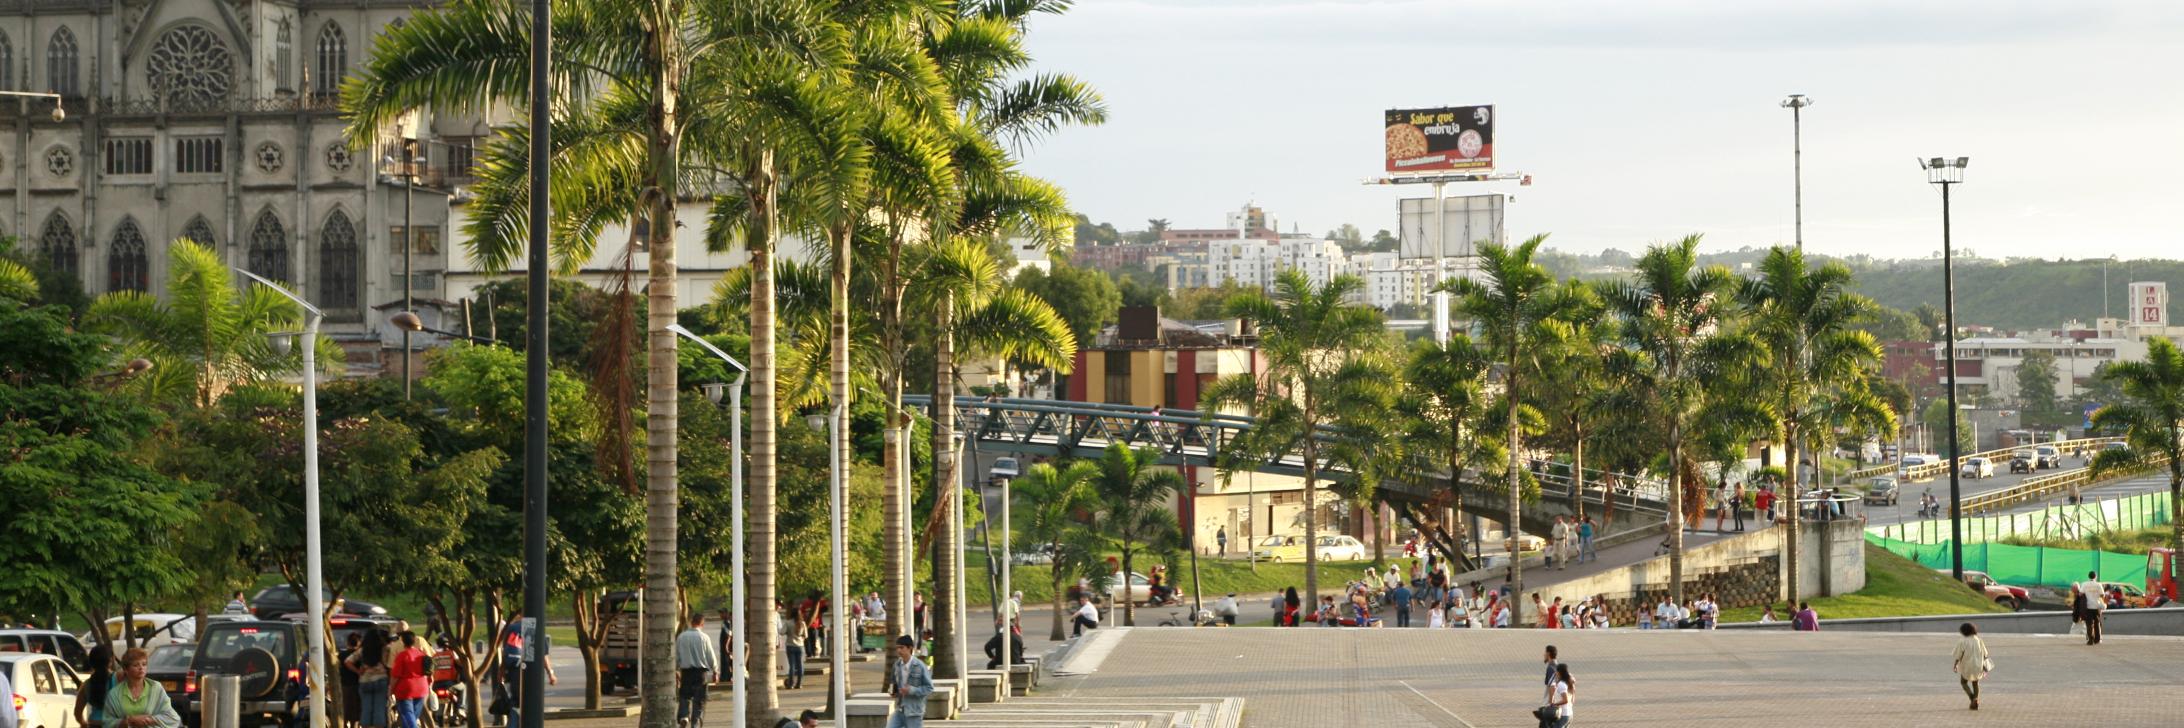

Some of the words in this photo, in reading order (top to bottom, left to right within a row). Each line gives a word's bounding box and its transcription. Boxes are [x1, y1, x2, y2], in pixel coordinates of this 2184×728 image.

[1410, 112, 1434, 125] Sabor
[1437, 112, 1454, 124] que
[1424, 122, 1460, 135] embruja
[2143, 307, 2159, 321] 14
